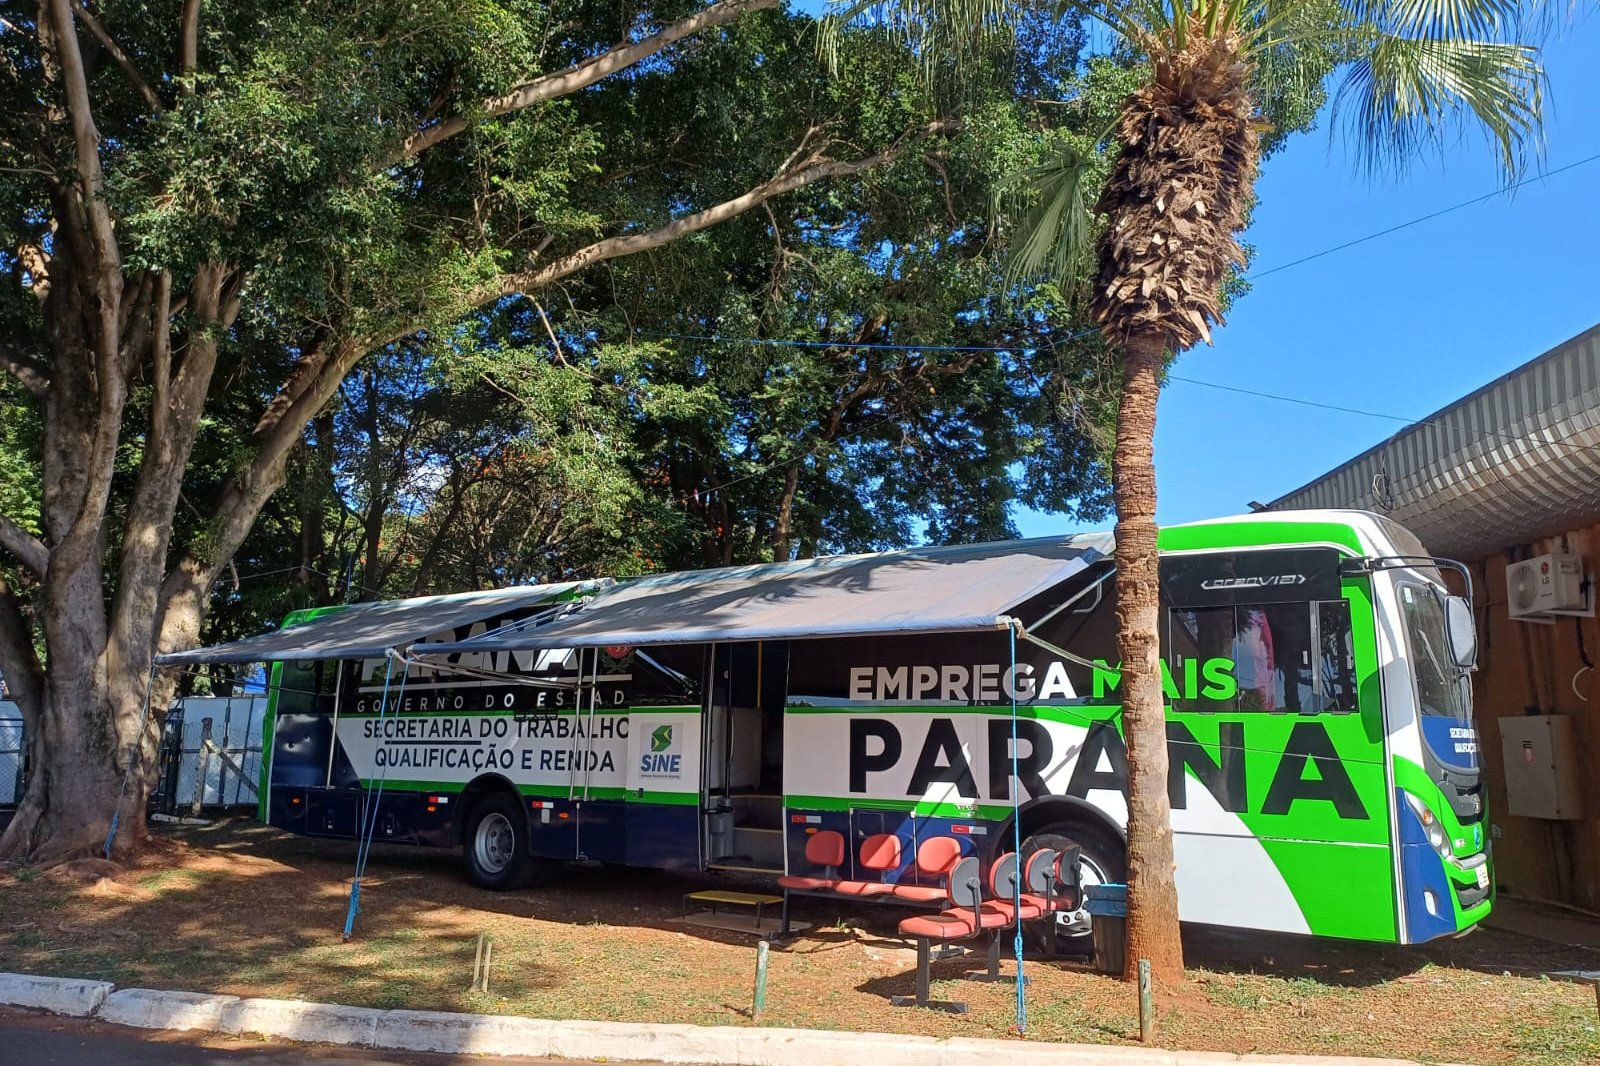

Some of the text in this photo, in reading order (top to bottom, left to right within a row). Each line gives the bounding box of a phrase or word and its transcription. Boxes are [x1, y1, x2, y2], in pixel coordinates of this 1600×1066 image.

[849, 661, 1079, 701] EMPREGA
[357, 695, 464, 713] GOVERNO
[485, 692, 515, 708] DO
[363, 716, 630, 739] SECRETARIA DO TRABALHO
[375, 743, 615, 772] QUALIFICAÇÃO E RENDA
